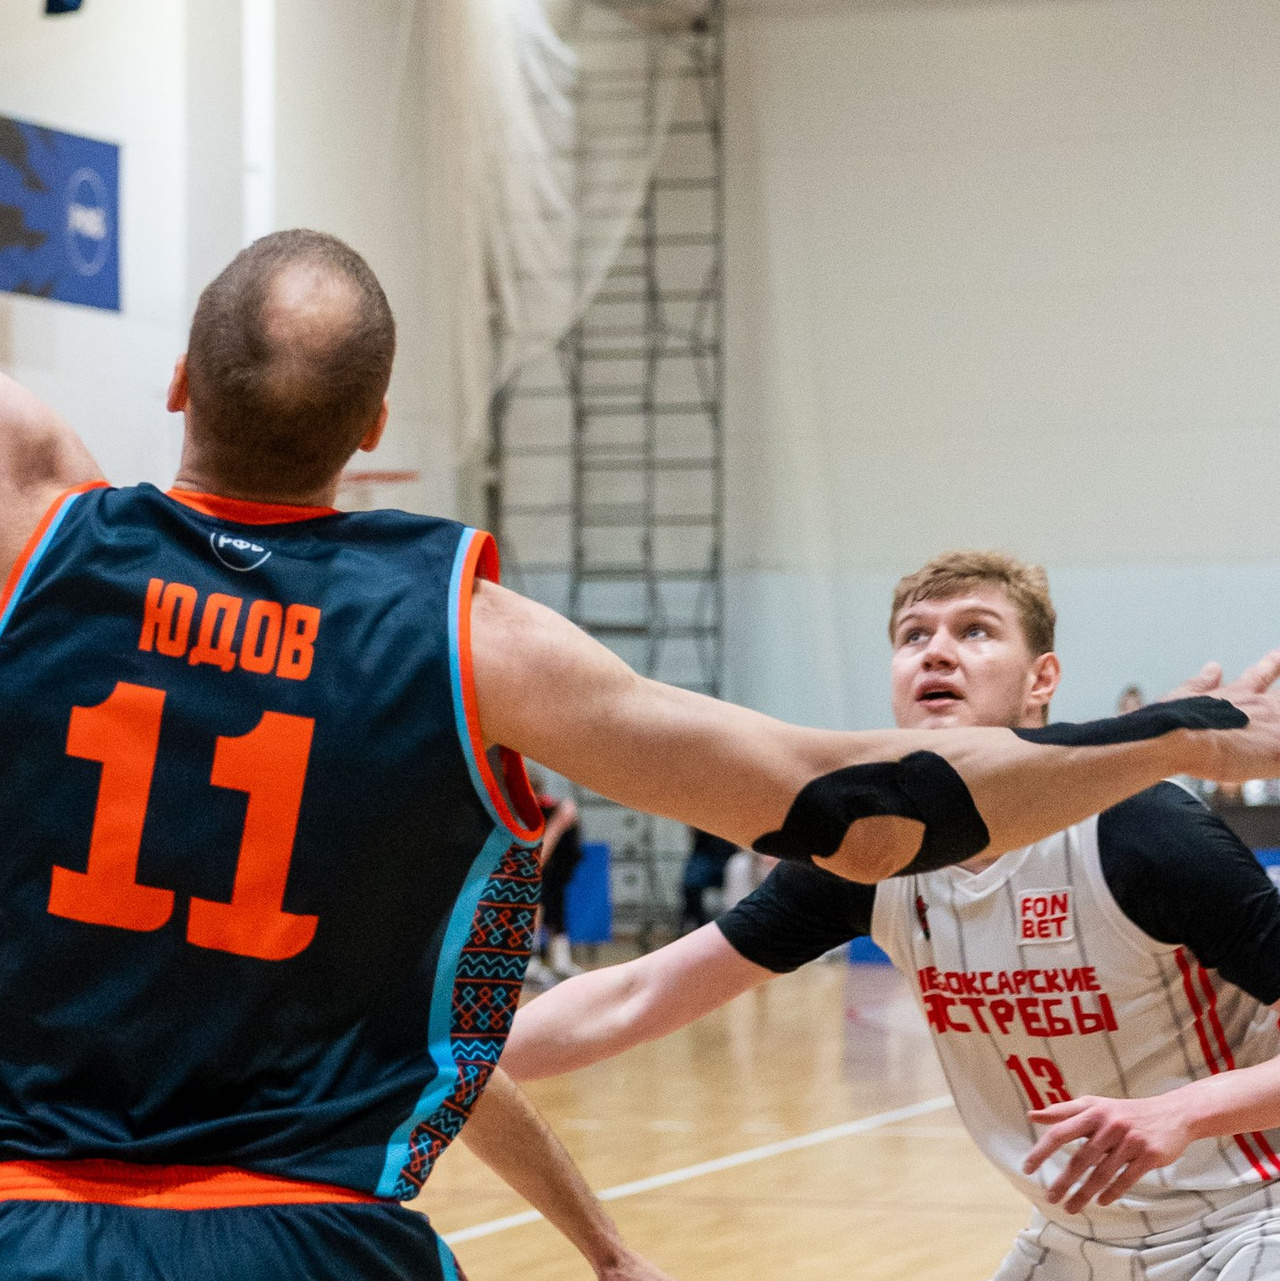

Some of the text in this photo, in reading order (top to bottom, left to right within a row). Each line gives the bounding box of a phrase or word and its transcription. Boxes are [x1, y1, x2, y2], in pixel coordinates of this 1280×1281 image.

[138, 578, 322, 682] ЮДОВ
[47, 681, 319, 961] 11
[1021, 893, 1068, 918] FON
[1022, 916, 1068, 939] BET
[1005, 1053, 1073, 1111] 13
